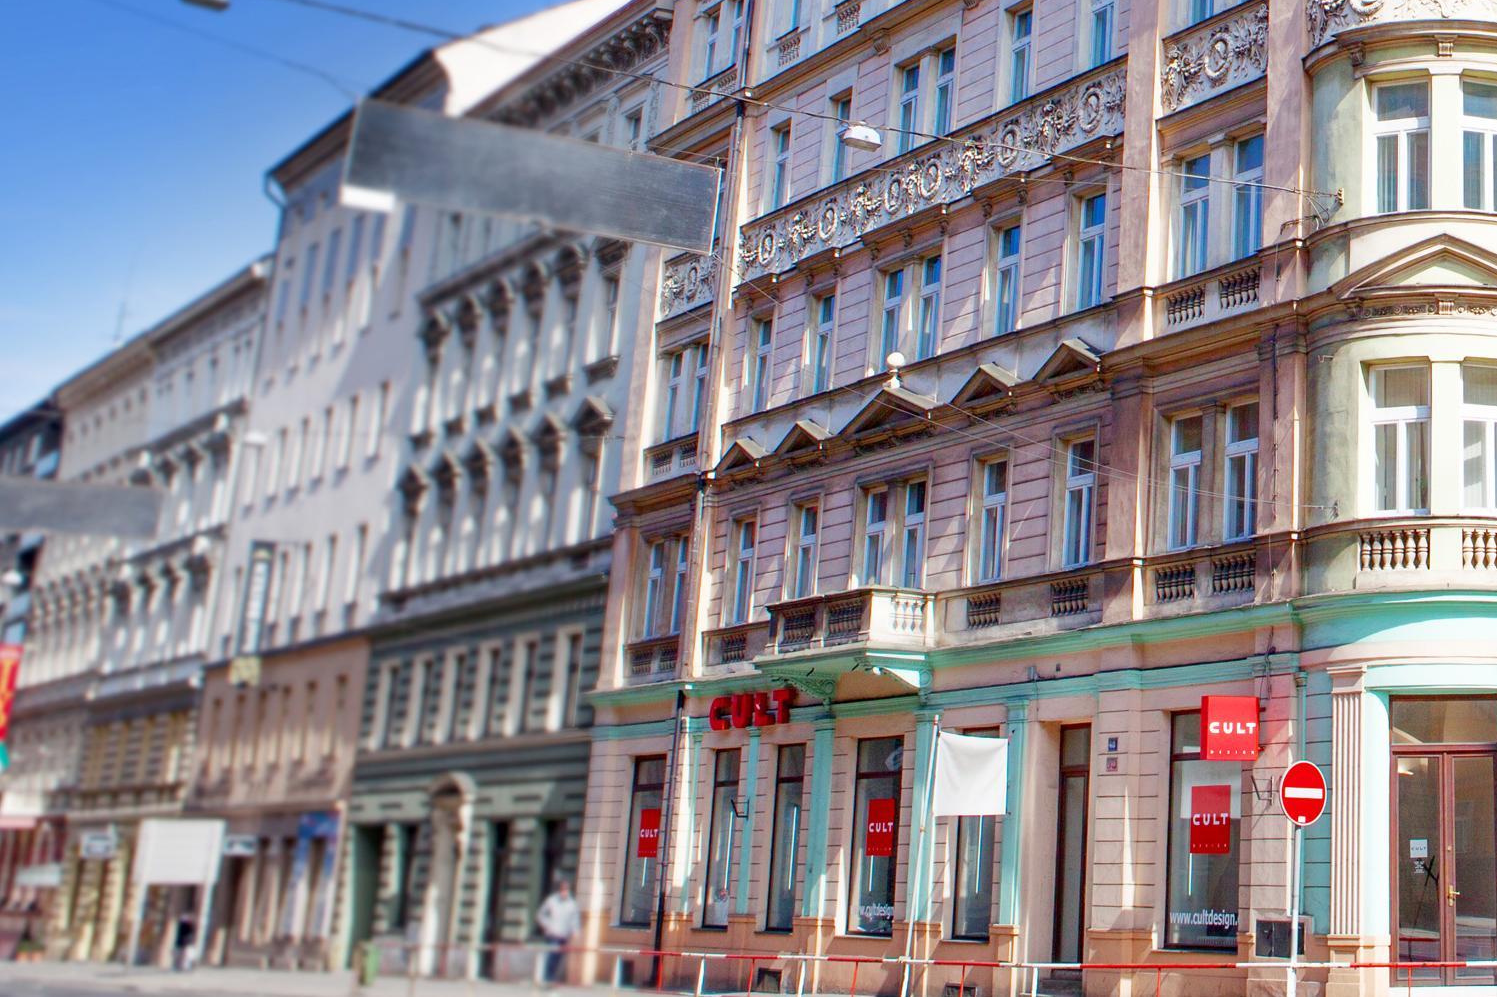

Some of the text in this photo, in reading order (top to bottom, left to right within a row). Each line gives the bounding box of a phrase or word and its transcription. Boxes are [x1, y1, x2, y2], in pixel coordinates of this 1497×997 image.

[710, 686, 798, 731] CULT
[1209, 721, 1257, 734] CULT
[1192, 812, 1229, 826] CULT
[640, 828, 659, 838] CULT
[868, 821, 894, 833] CULT
